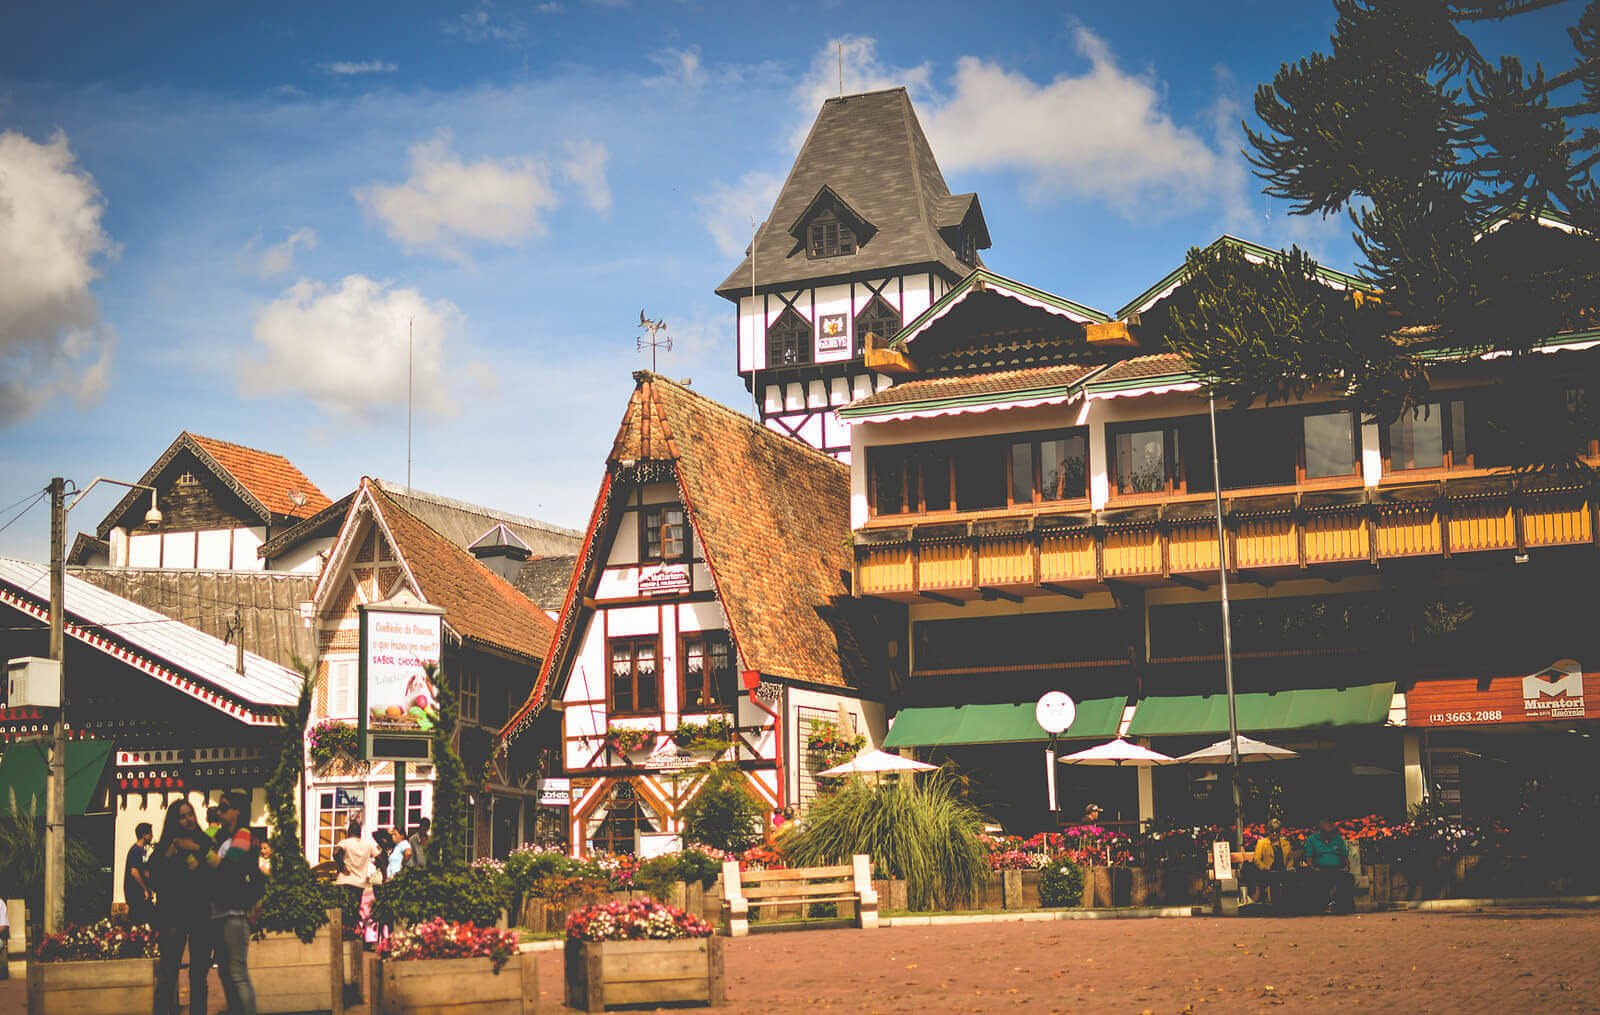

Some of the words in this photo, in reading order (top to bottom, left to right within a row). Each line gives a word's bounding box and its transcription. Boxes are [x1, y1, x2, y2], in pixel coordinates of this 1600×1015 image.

[378, 641, 389, 653] que
[373, 655, 395, 665] SABOR
[1524, 697, 1585, 710] Muratori
[1446, 710, 1502, 723] 3663.2088
